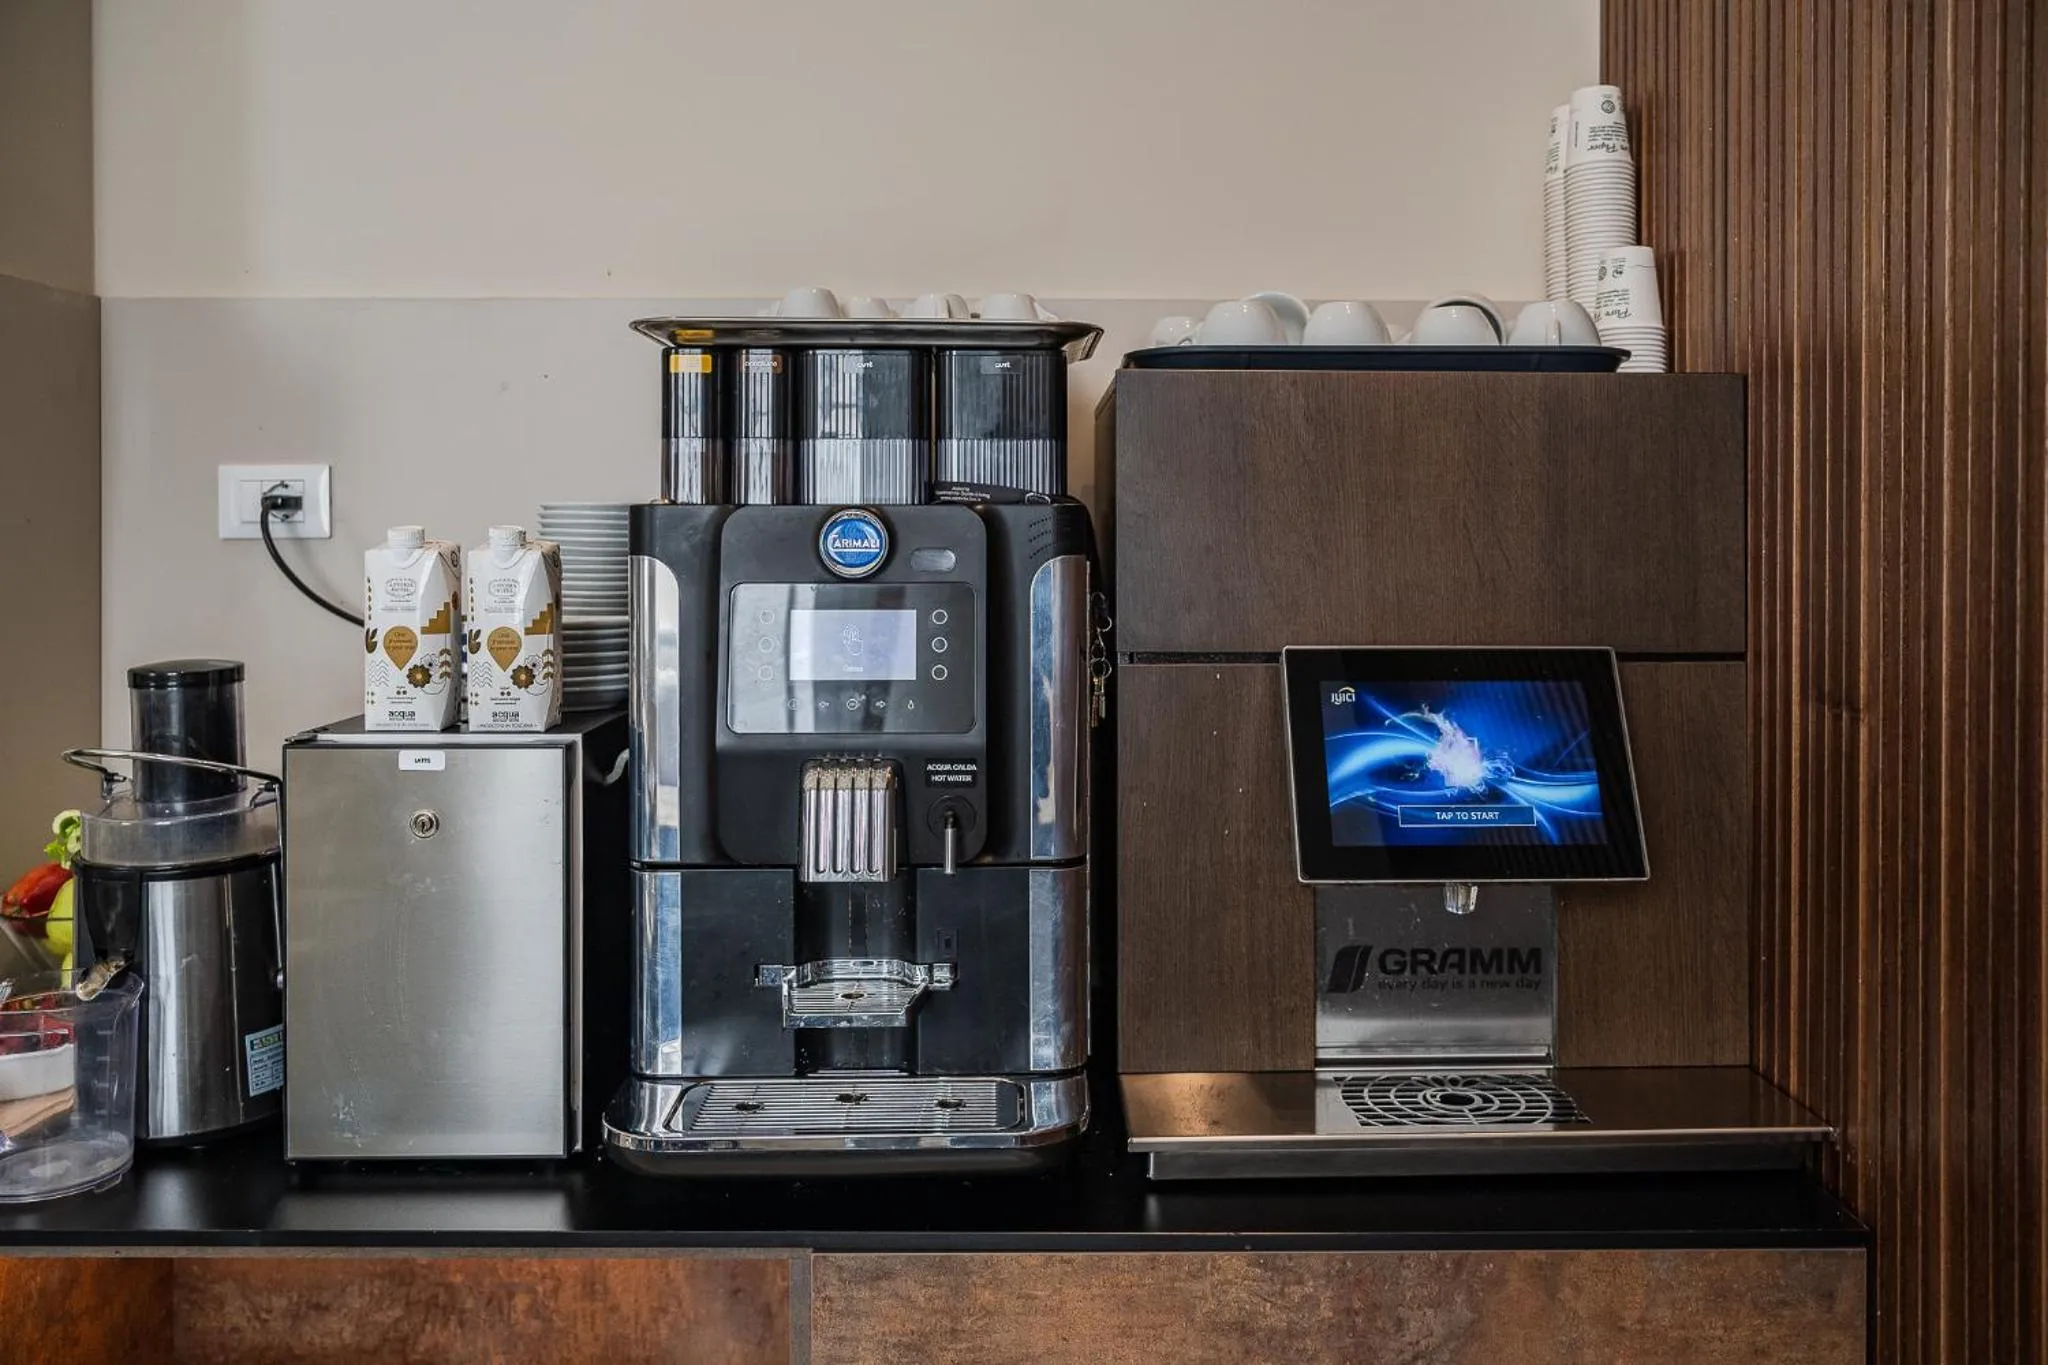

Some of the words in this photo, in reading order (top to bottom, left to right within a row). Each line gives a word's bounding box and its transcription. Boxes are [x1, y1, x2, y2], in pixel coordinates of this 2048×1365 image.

[388, 710, 416, 719] acqua
[491, 711, 520, 720] acqua
[926, 763, 952, 771] ACQUA
[952, 763, 977, 771] CALDA
[931, 774, 946, 782] HOT
[946, 774, 973, 782] WATER
[1435, 811, 1454, 820] TAP
[1455, 811, 1469, 820] TO
[1470, 811, 1500, 820] START
[1378, 947, 1543, 976] GRAMM
[1378, 979, 1417, 993] every
[1421, 977, 1448, 991] day
[1452, 977, 1464, 990] is
[1480, 979, 1510, 989] new
[1515, 977, 1542, 991] day
